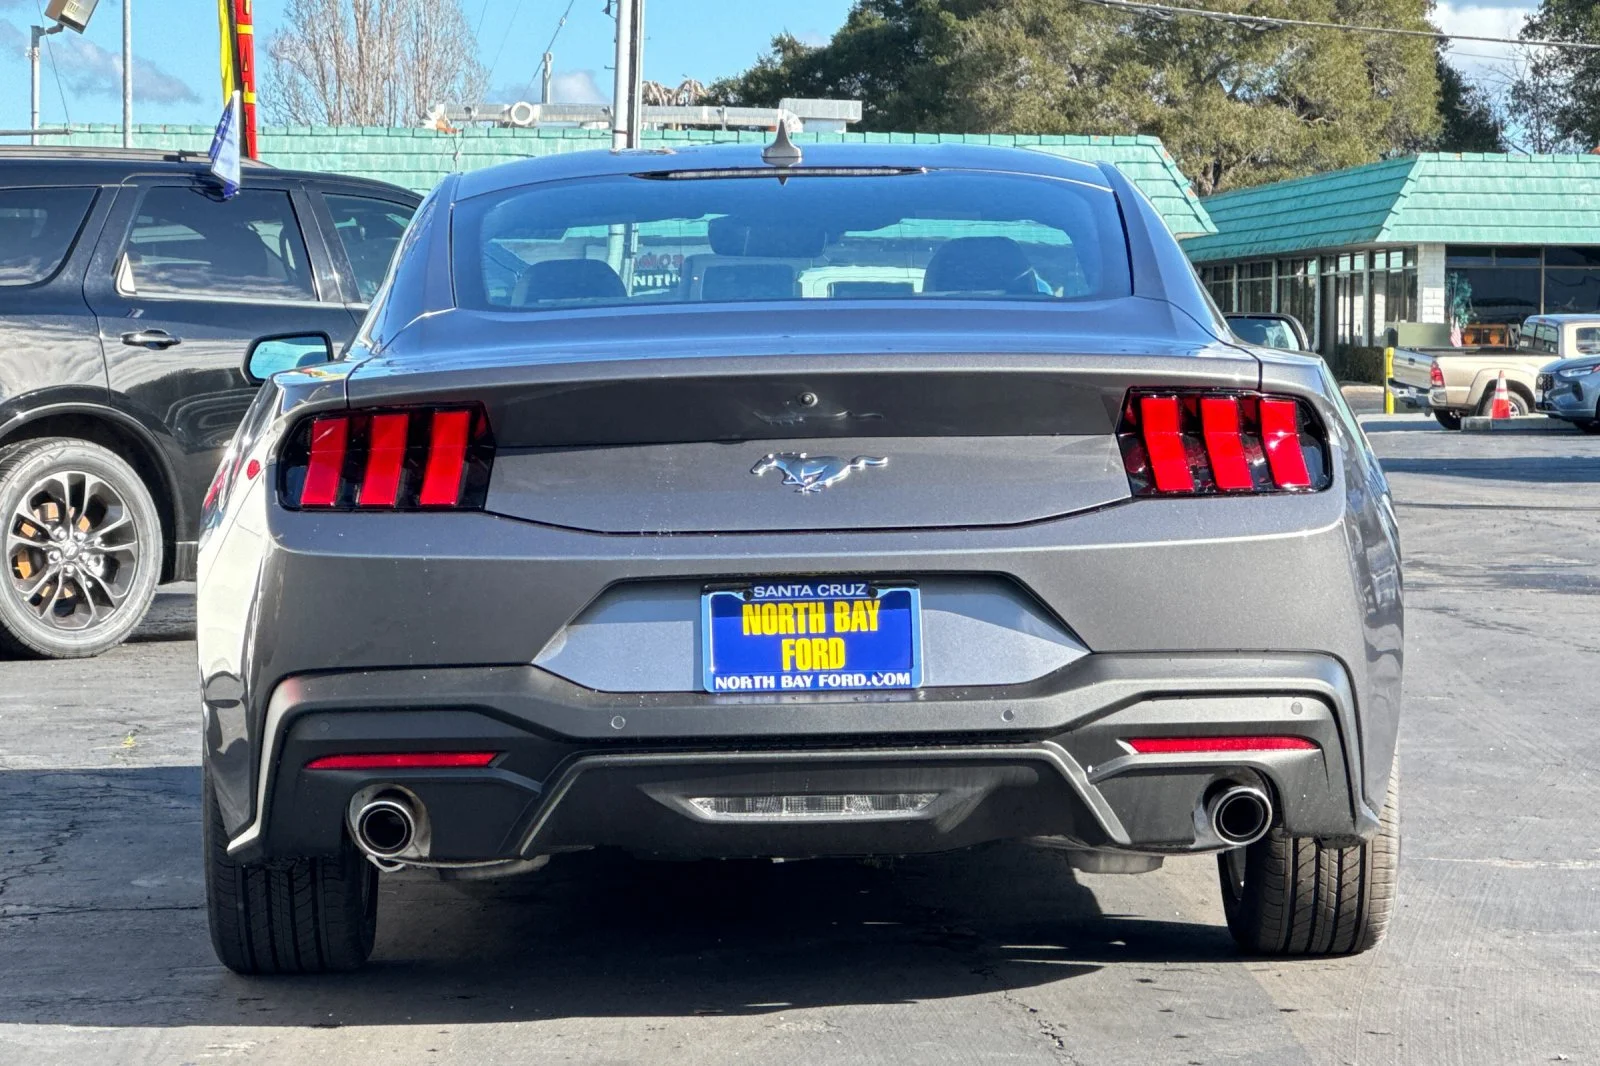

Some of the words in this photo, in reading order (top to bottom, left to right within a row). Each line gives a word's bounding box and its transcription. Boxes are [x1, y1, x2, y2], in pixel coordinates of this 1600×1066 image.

[753, 585, 813, 598] SANTA
[817, 583, 867, 596] CRUZ
[742, 600, 825, 635] NORTH
[833, 599, 881, 633] BAY
[781, 637, 845, 671] FORD
[715, 674, 775, 690] NORTH
[781, 674, 813, 688] BAY
[818, 672, 911, 687] FORD.COM
